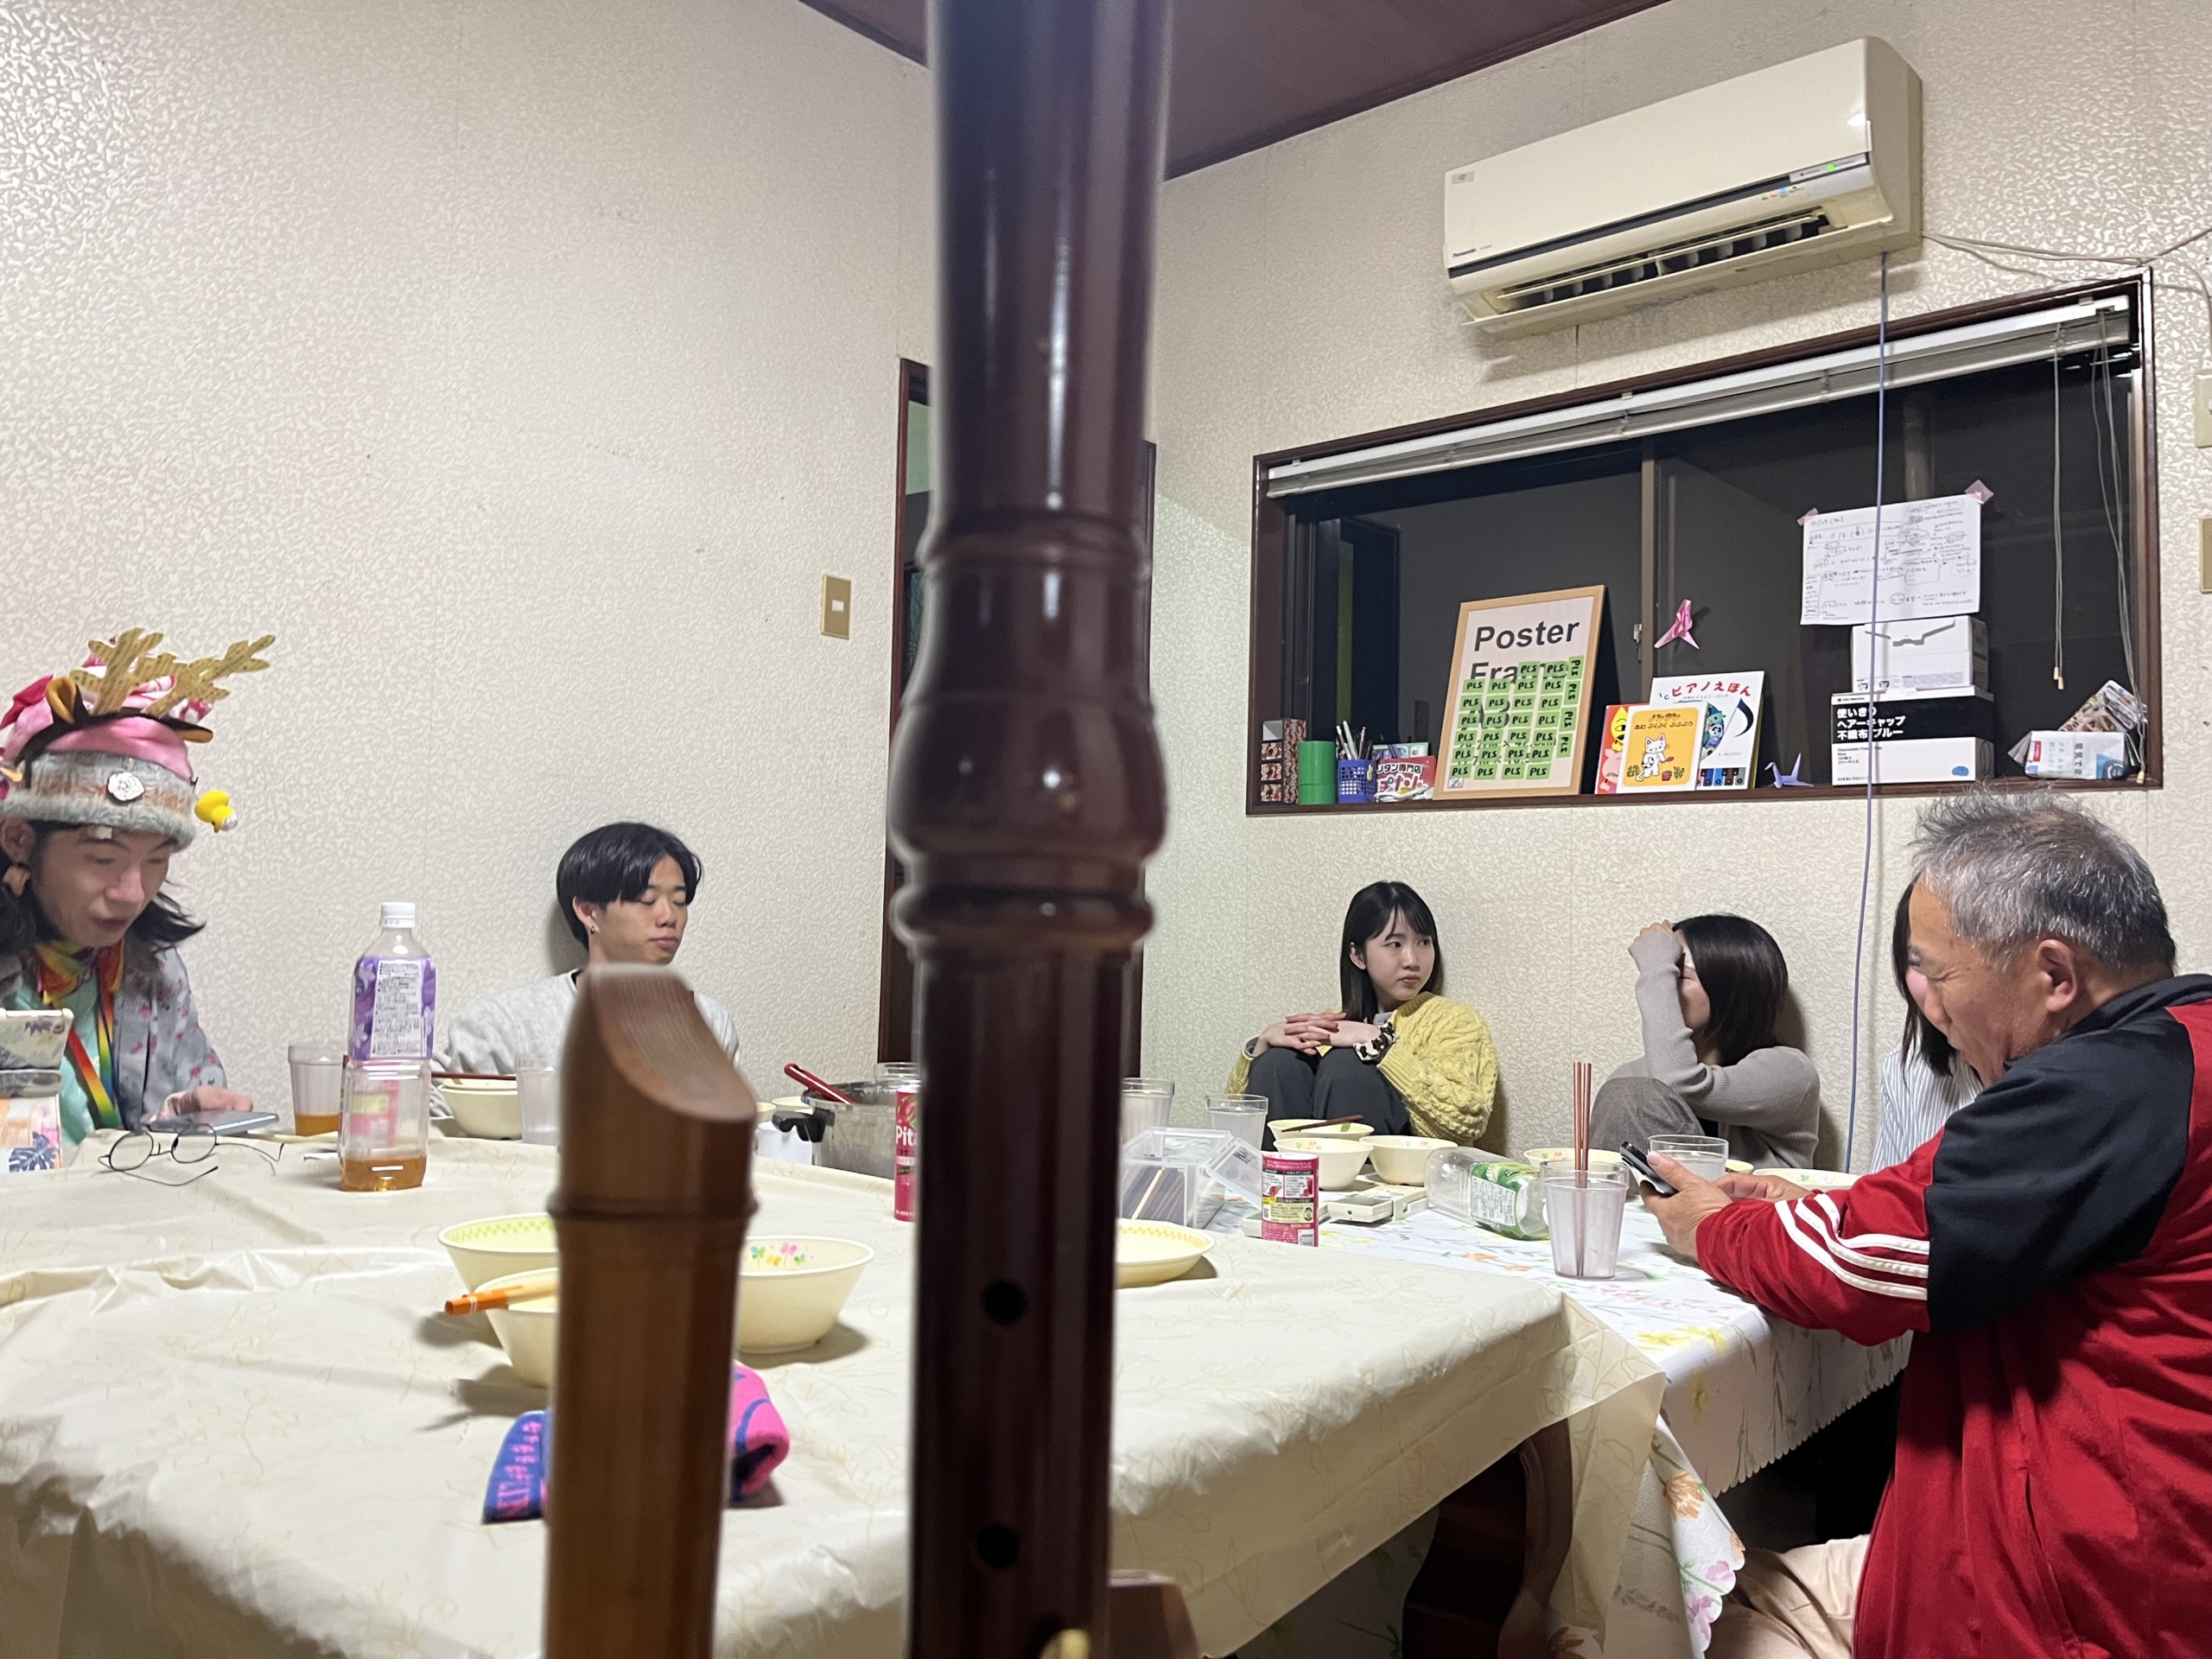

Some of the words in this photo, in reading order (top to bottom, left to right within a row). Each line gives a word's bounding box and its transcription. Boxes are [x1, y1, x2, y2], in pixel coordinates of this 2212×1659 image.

[1474, 620, 1580, 652] Poster
[1470, 661, 1568, 684] Fra
[1521, 664, 1537, 674] PLS
[1547, 664, 1565, 674] PLS
[1571, 659, 1581, 677] PLS
[1466, 681, 1483, 690] PLS
[1491, 682, 1507, 690] PLS
[1517, 681, 1535, 690] PLS
[1544, 681, 1561, 690] PLS
[1567, 683, 1578, 700] PLS
[1672, 681, 1751, 696] ピアノえほん
[1463, 698, 1479, 708] PLS
[1489, 698, 1504, 708] PLS
[1514, 698, 1532, 708] PLS
[1541, 698, 1559, 709] PLS
[1837, 706, 1878, 719] 使いきり
[1461, 716, 1478, 725] PLS
[1486, 715, 1502, 726] PLS
[1512, 715, 1529, 725] PLS
[1538, 715, 1555, 726] PLS
[1564, 711, 1573, 728] PLS
[1837, 715, 1906, 728] ヘアーキャップ
[1458, 733, 1474, 742] PLS
[1483, 733, 1499, 742] PLS
[1510, 732, 1527, 741] PLS
[1535, 732, 1553, 741] PLS
[1560, 736, 1569, 753] PLS
[1455, 750, 1471, 760] PLS
[1481, 750, 1497, 760] PLS
[1508, 749, 1524, 759] PLS
[1531, 749, 1549, 759] PLS
[1452, 766, 1468, 777] PLS
[1477, 767, 1494, 777] PLS
[1503, 766, 1521, 776] PLS
[1529, 767, 1548, 777] PLS
